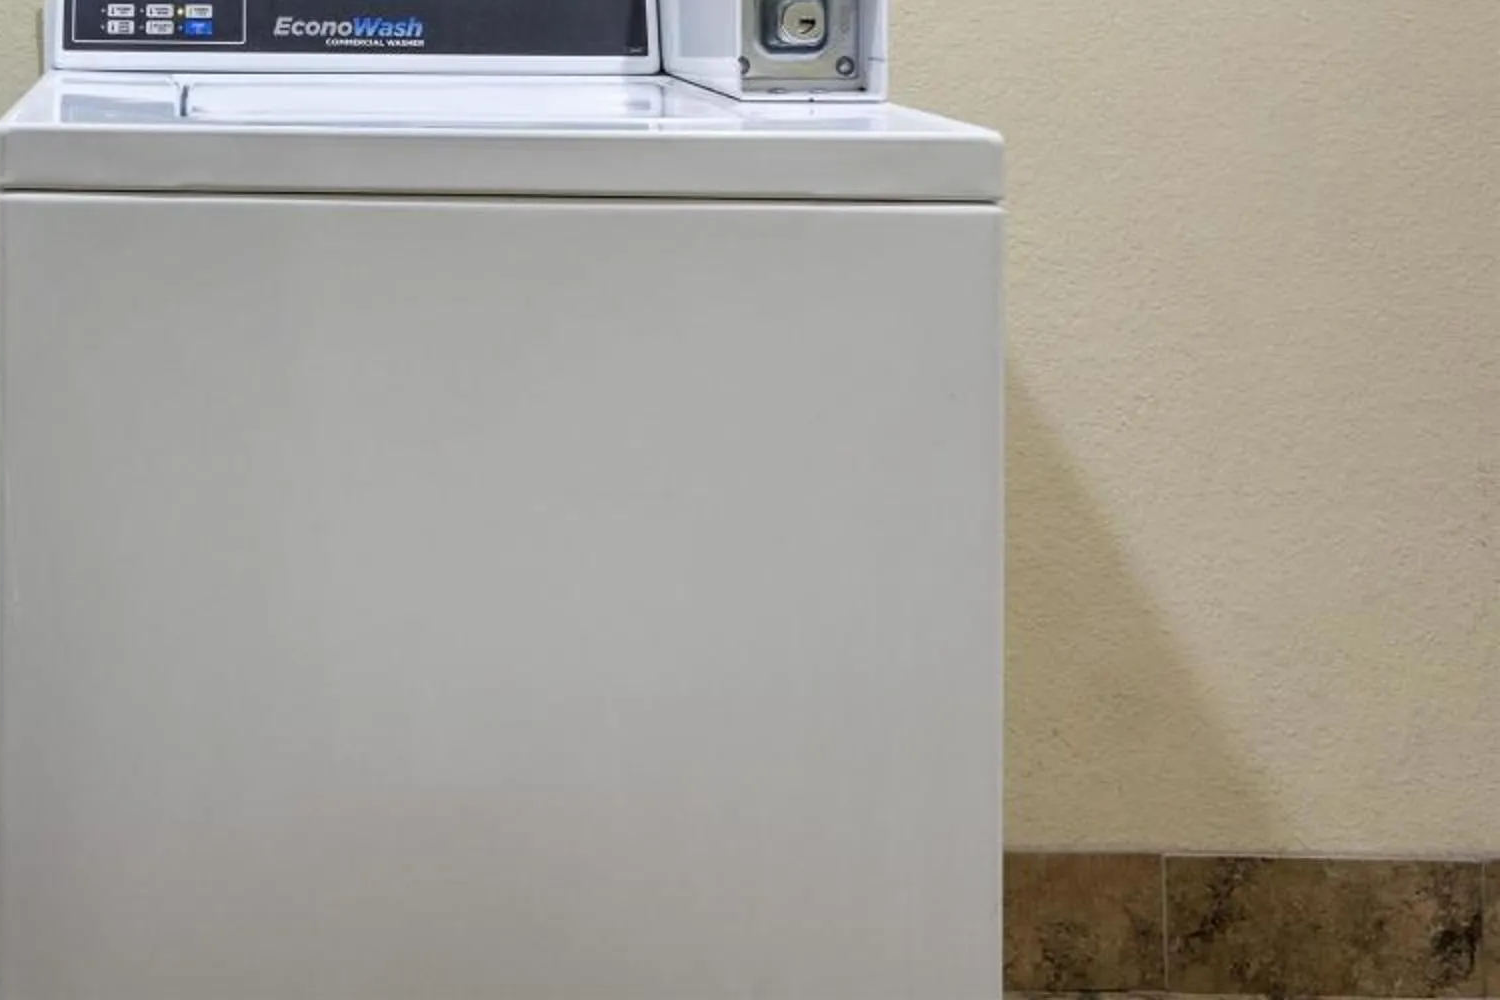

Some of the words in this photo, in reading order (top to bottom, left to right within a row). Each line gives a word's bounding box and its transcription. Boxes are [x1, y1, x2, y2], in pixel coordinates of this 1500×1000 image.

[273, 16, 423, 36] EconoWash
[325, 37, 385, 47] COMMERCIAL
[386, 38, 425, 47] WASHER
